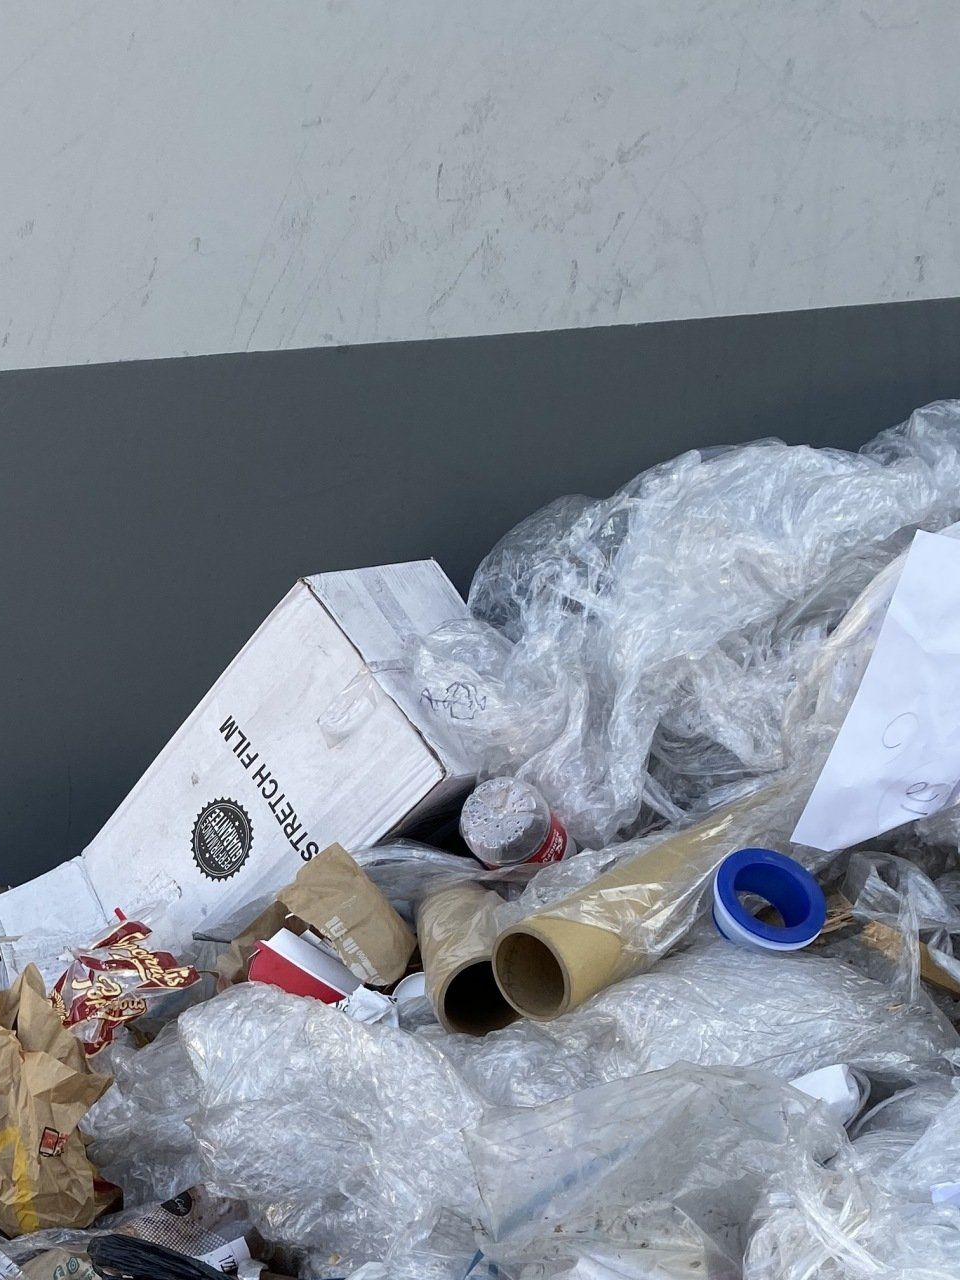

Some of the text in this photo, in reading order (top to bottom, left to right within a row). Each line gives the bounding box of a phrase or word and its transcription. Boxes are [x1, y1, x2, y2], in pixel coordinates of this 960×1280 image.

[219, 715, 319, 861] STRETCH FILM
[200, 817, 232, 870] PERFORMANCE
[208, 808, 243, 862] GUARANTEE
